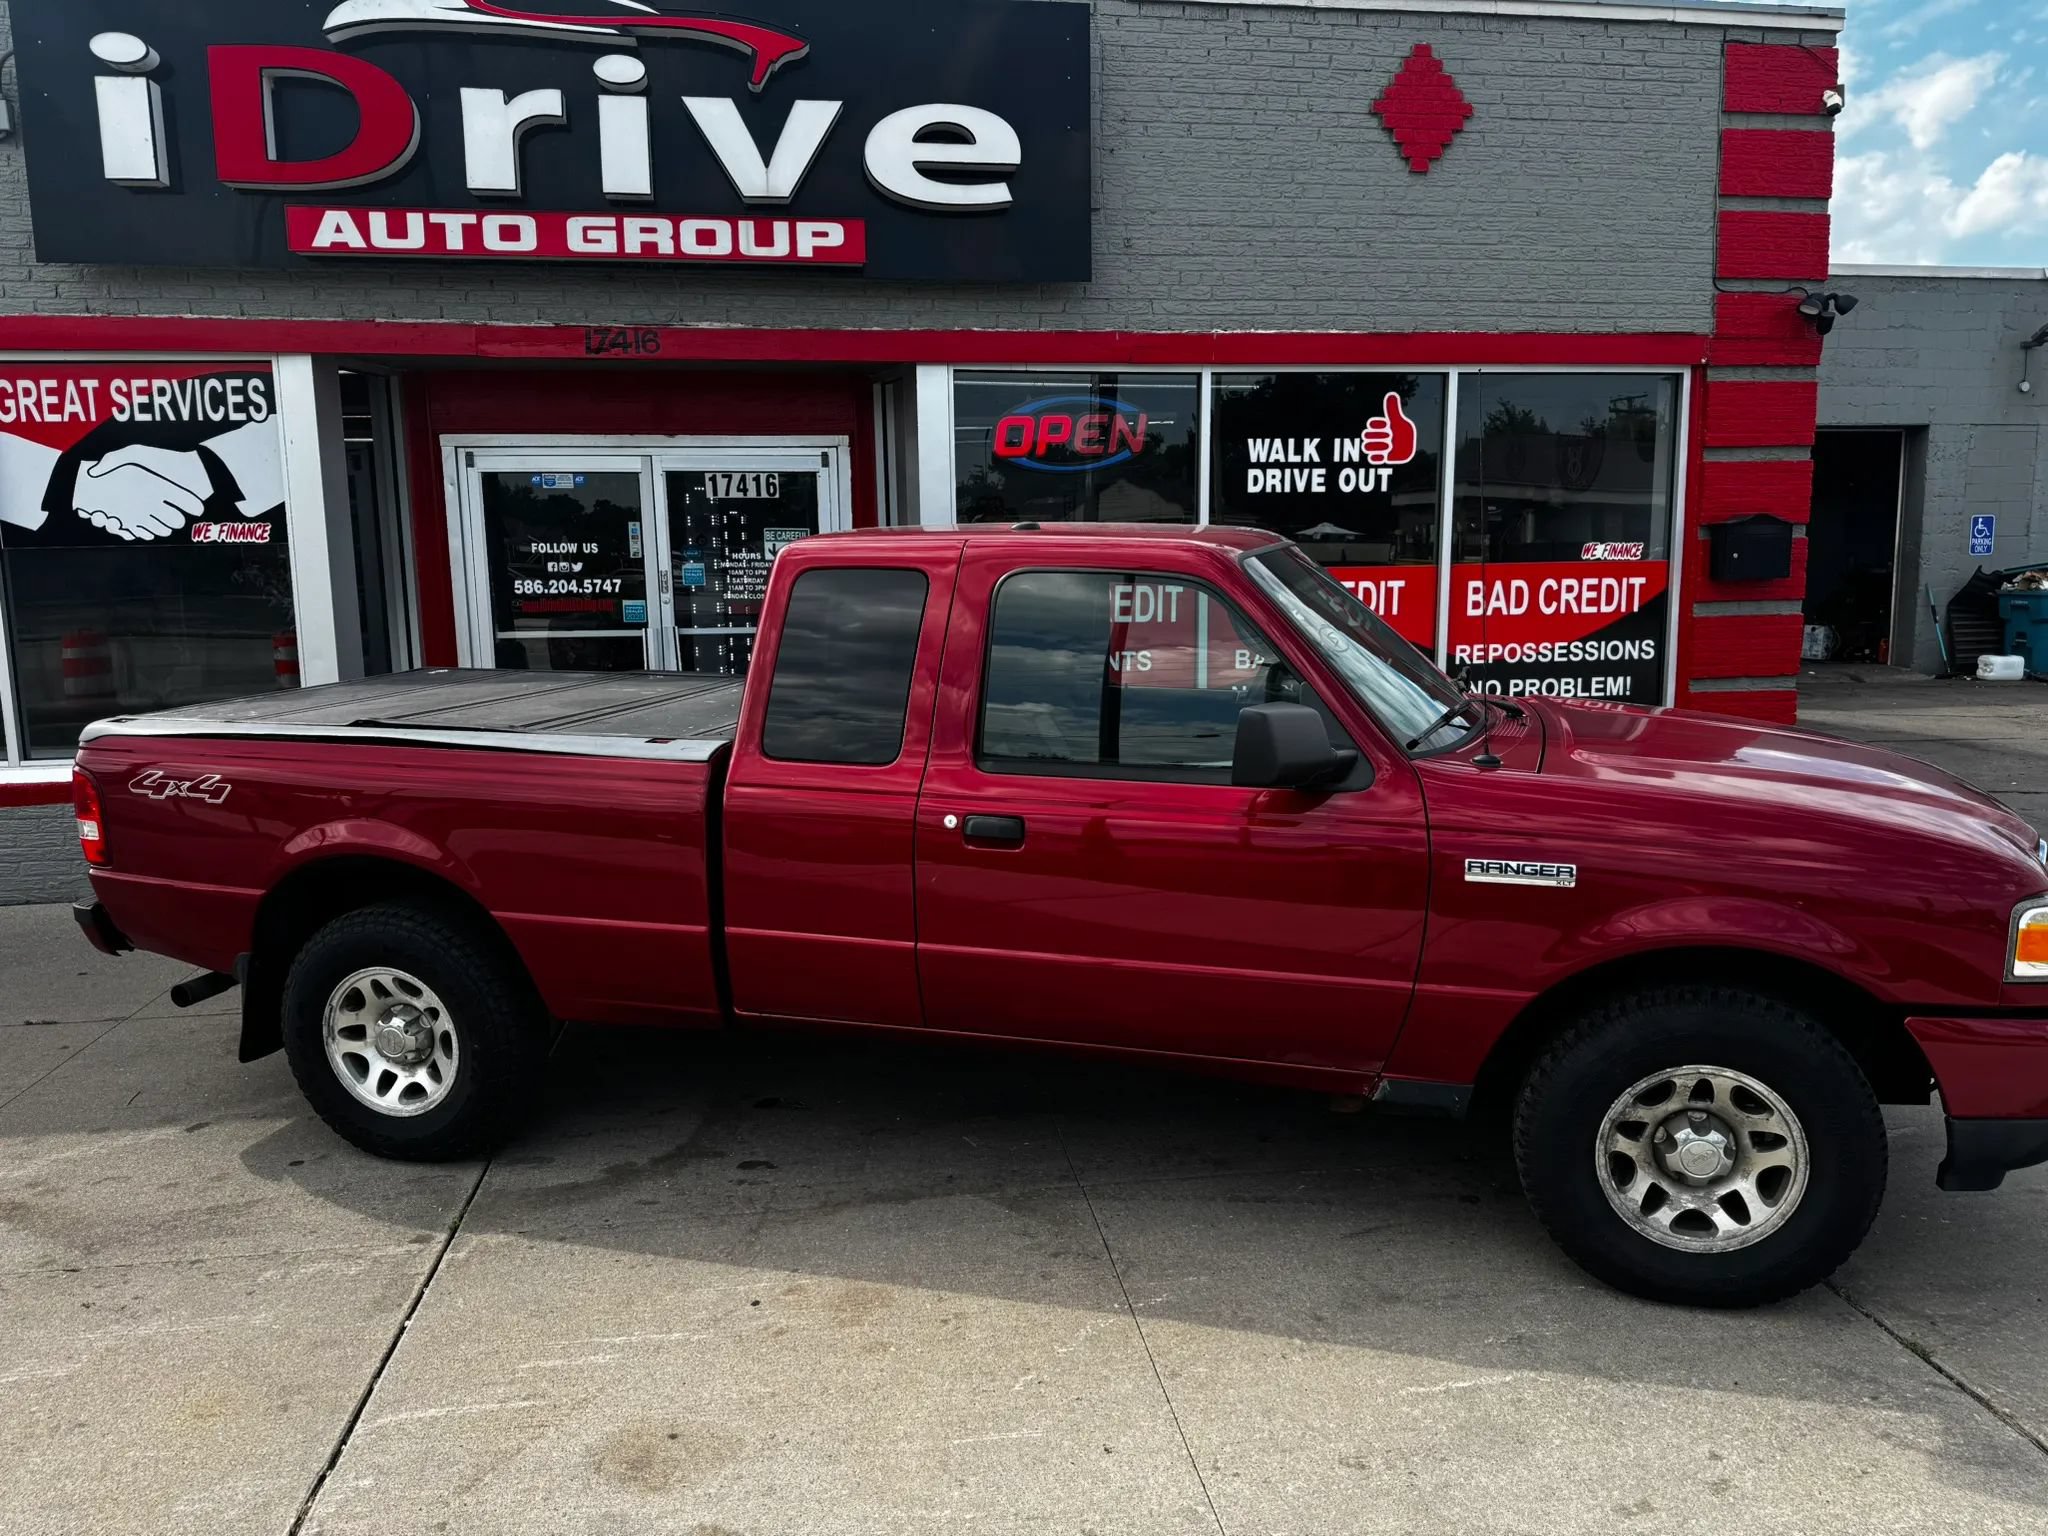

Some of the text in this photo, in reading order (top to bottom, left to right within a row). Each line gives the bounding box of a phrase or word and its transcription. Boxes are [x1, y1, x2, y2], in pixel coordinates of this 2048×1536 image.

[89, 32, 1022, 208] iDrive
[311, 210, 845, 258] AUTO GROUP
[0, 377, 269, 424] GREAT SERVICES
[992, 412, 1148, 459] OPEN
[1247, 437, 1361, 464] WALK IN
[708, 473, 778, 498] 17416
[1247, 467, 1393, 494] DRIVE OUT
[191, 522, 272, 543] WE FINANCE
[1971, 537, 1992, 546] PARKING
[531, 542, 599, 554] FOLLOW US
[732, 552, 761, 560] HOURS
[1581, 542, 1645, 561] WE FINANCE
[1974, 545, 1988, 553] ONLY
[513, 579, 622, 594] 586.204.5747
[1466, 576, 1647, 617] BAD CREDIT
[1109, 585, 1184, 623] EDIT
[1455, 639, 1655, 665] REPOSSESSIONS
[1470, 676, 1632, 698] NO PROBLEM!
[128, 770, 232, 804] 4x4
[1467, 860, 1575, 878] RANGER
